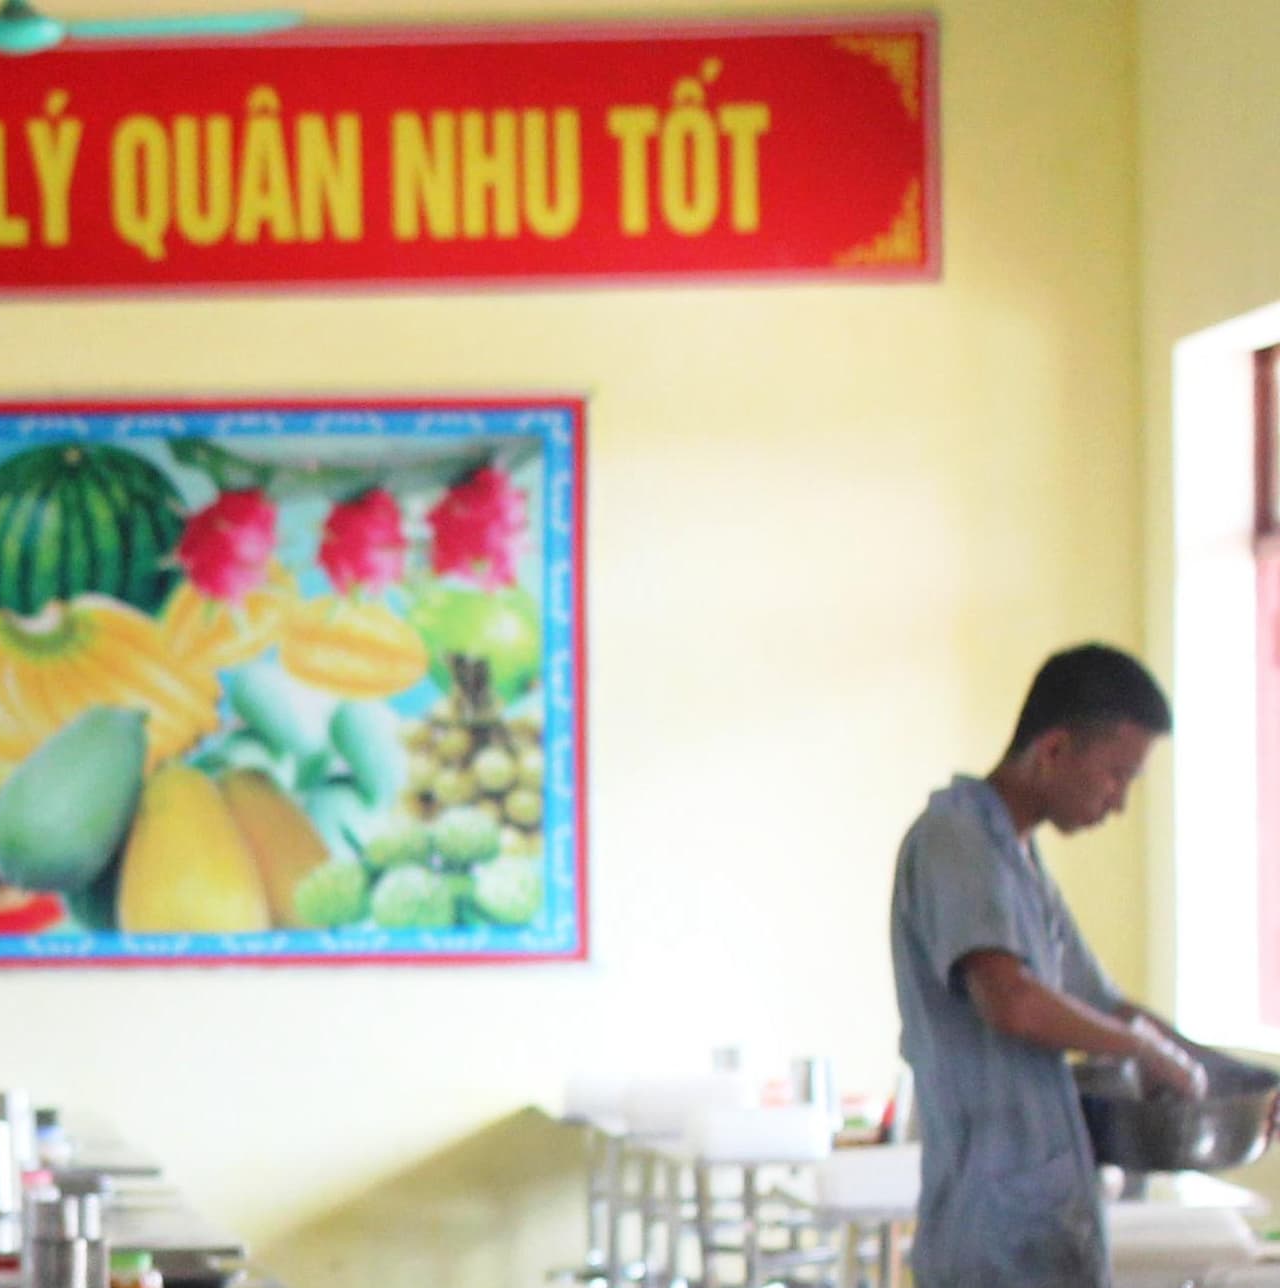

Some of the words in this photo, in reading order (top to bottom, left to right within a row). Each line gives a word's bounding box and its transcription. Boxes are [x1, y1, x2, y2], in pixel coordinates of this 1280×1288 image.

[109, 84, 364, 262] QUÂN
[390, 105, 583, 242] NHU
[606, 56, 772, 237] TỐT
